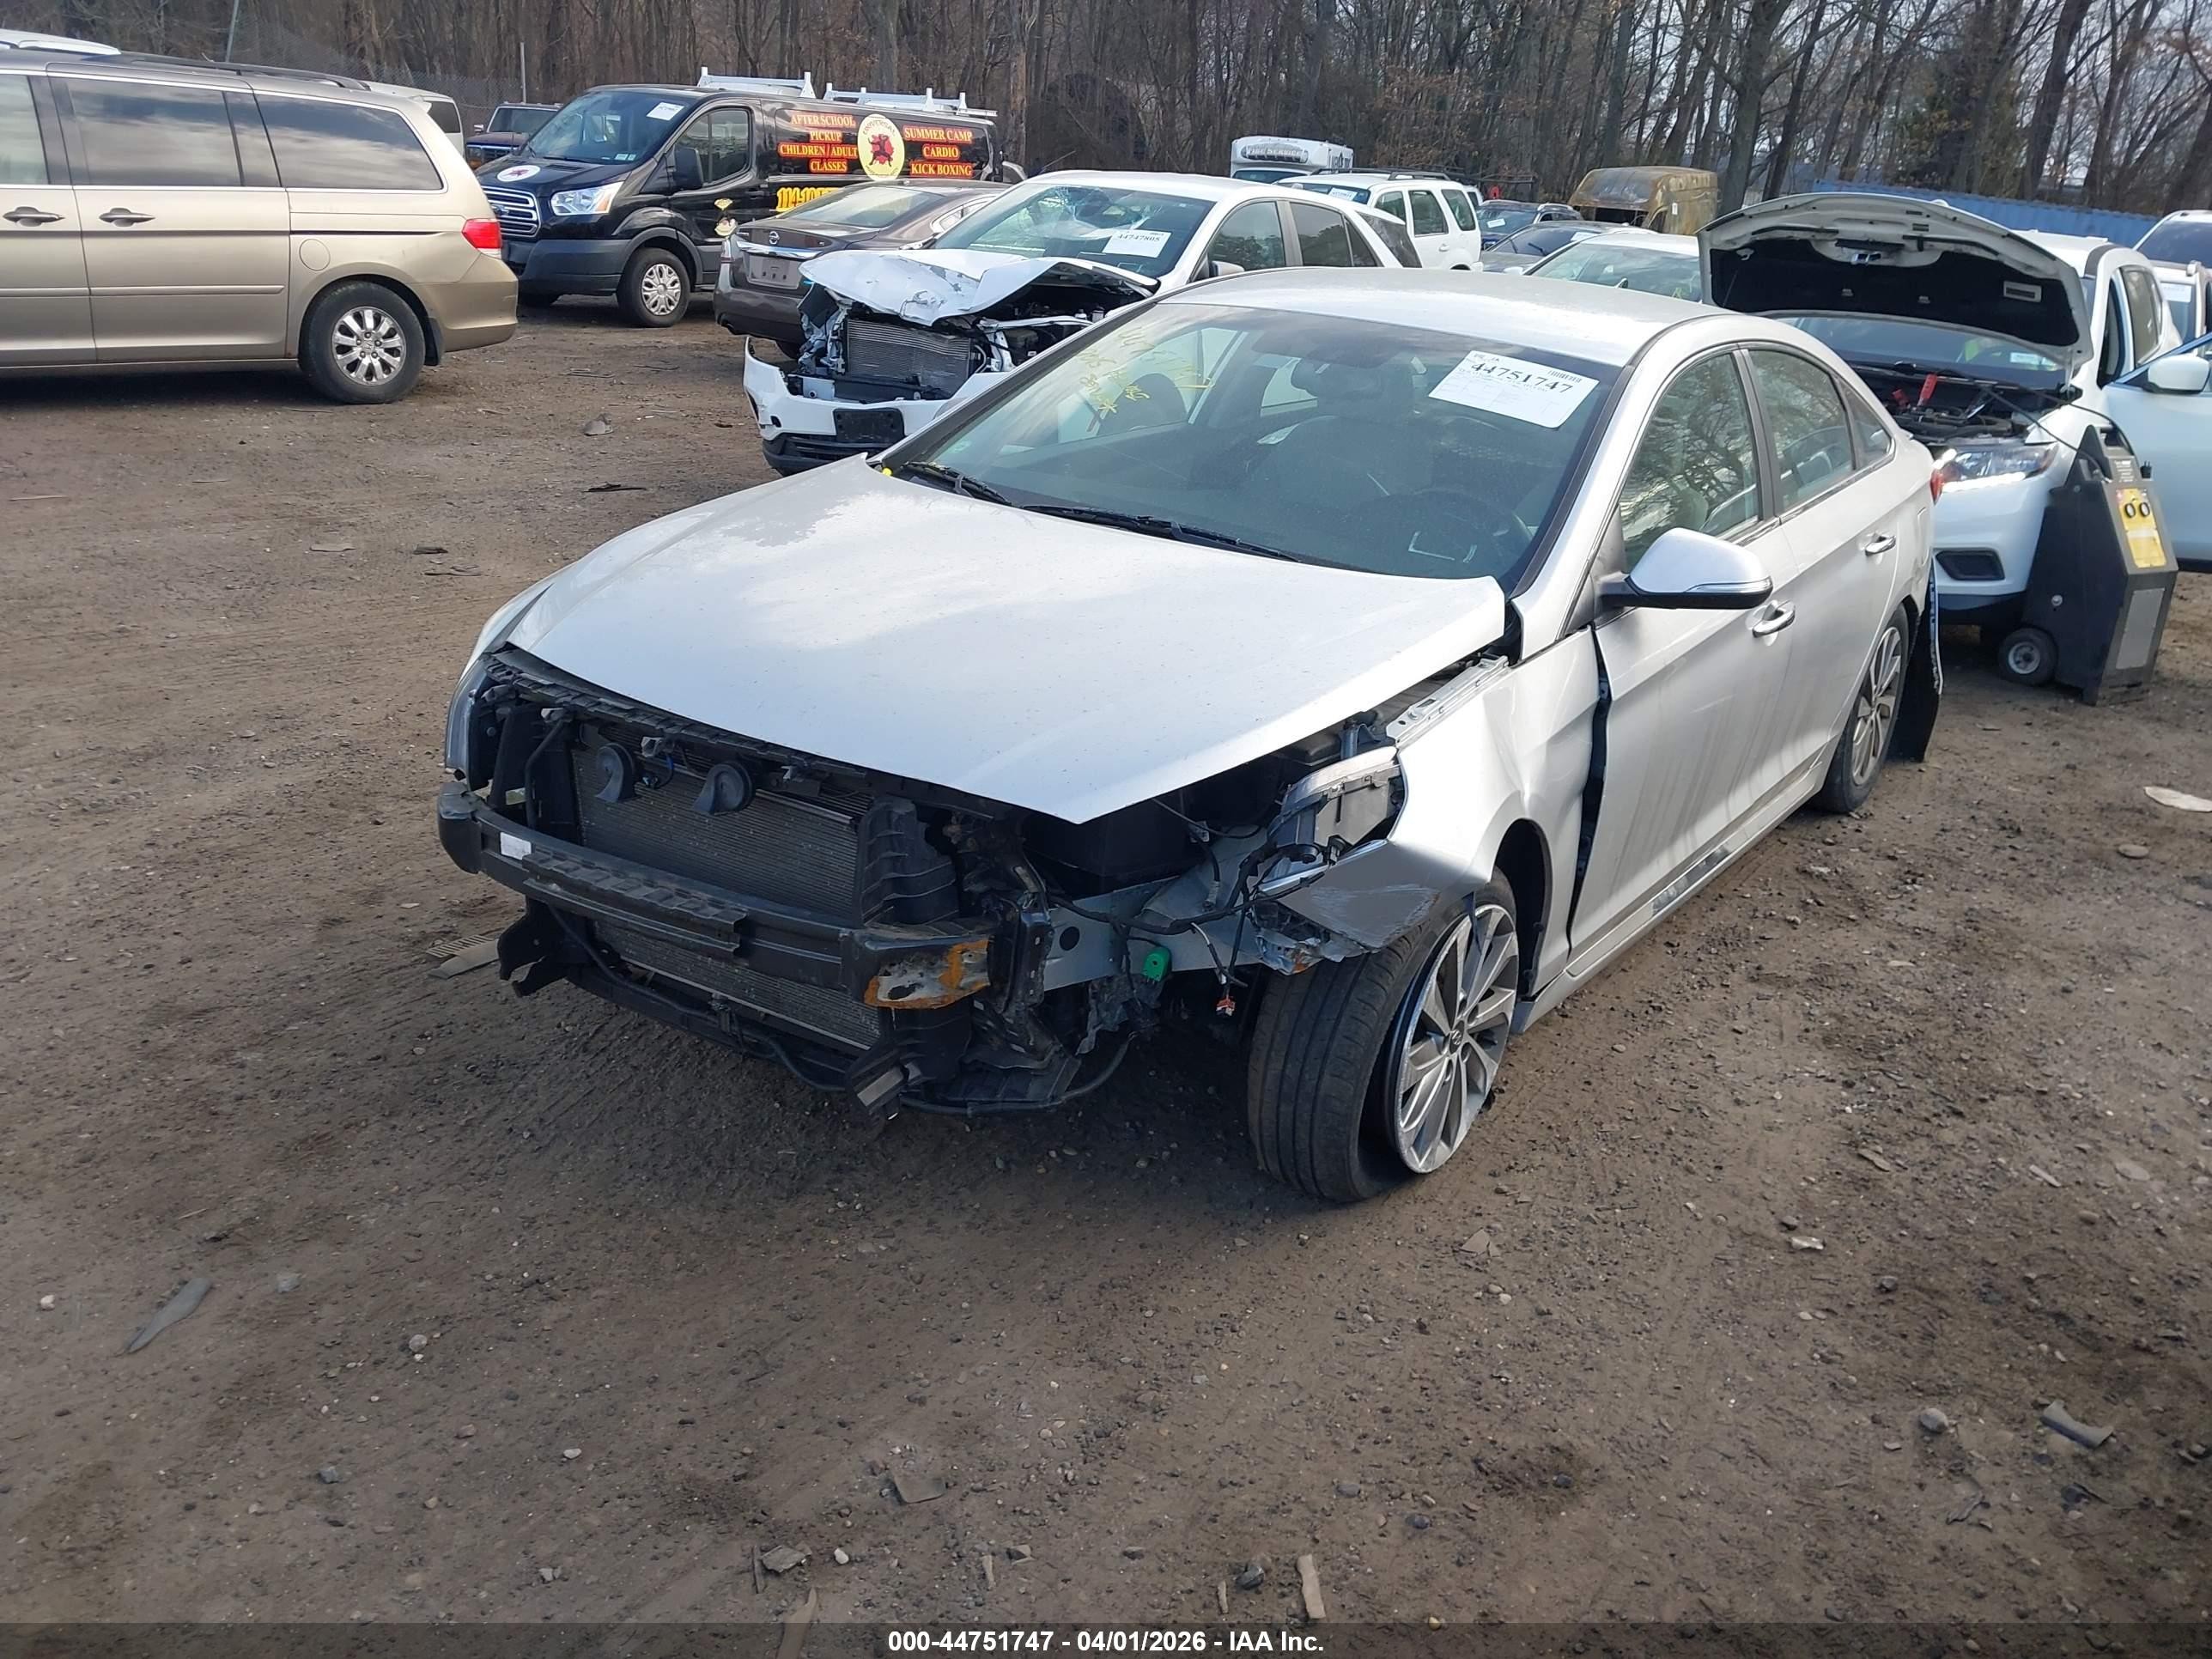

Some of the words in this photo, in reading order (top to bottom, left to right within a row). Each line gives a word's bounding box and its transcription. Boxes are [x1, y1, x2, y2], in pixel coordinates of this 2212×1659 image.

[790, 114, 820, 125] AFTER
[821, 115, 856, 127] SCHOOL
[809, 130, 842, 142] PICKUP
[904, 127, 946, 141] SUMMER
[946, 130, 973, 142] CAMP
[780, 143, 825, 155] CHILDREN
[830, 145, 858, 158] ADULT
[922, 146, 959, 159] CARDIO
[810, 160, 848, 172] CLASSES
[911, 163, 935, 175] KICK
[936, 163, 972, 177] BOXING
[1471, 362, 1573, 393] 44751747
